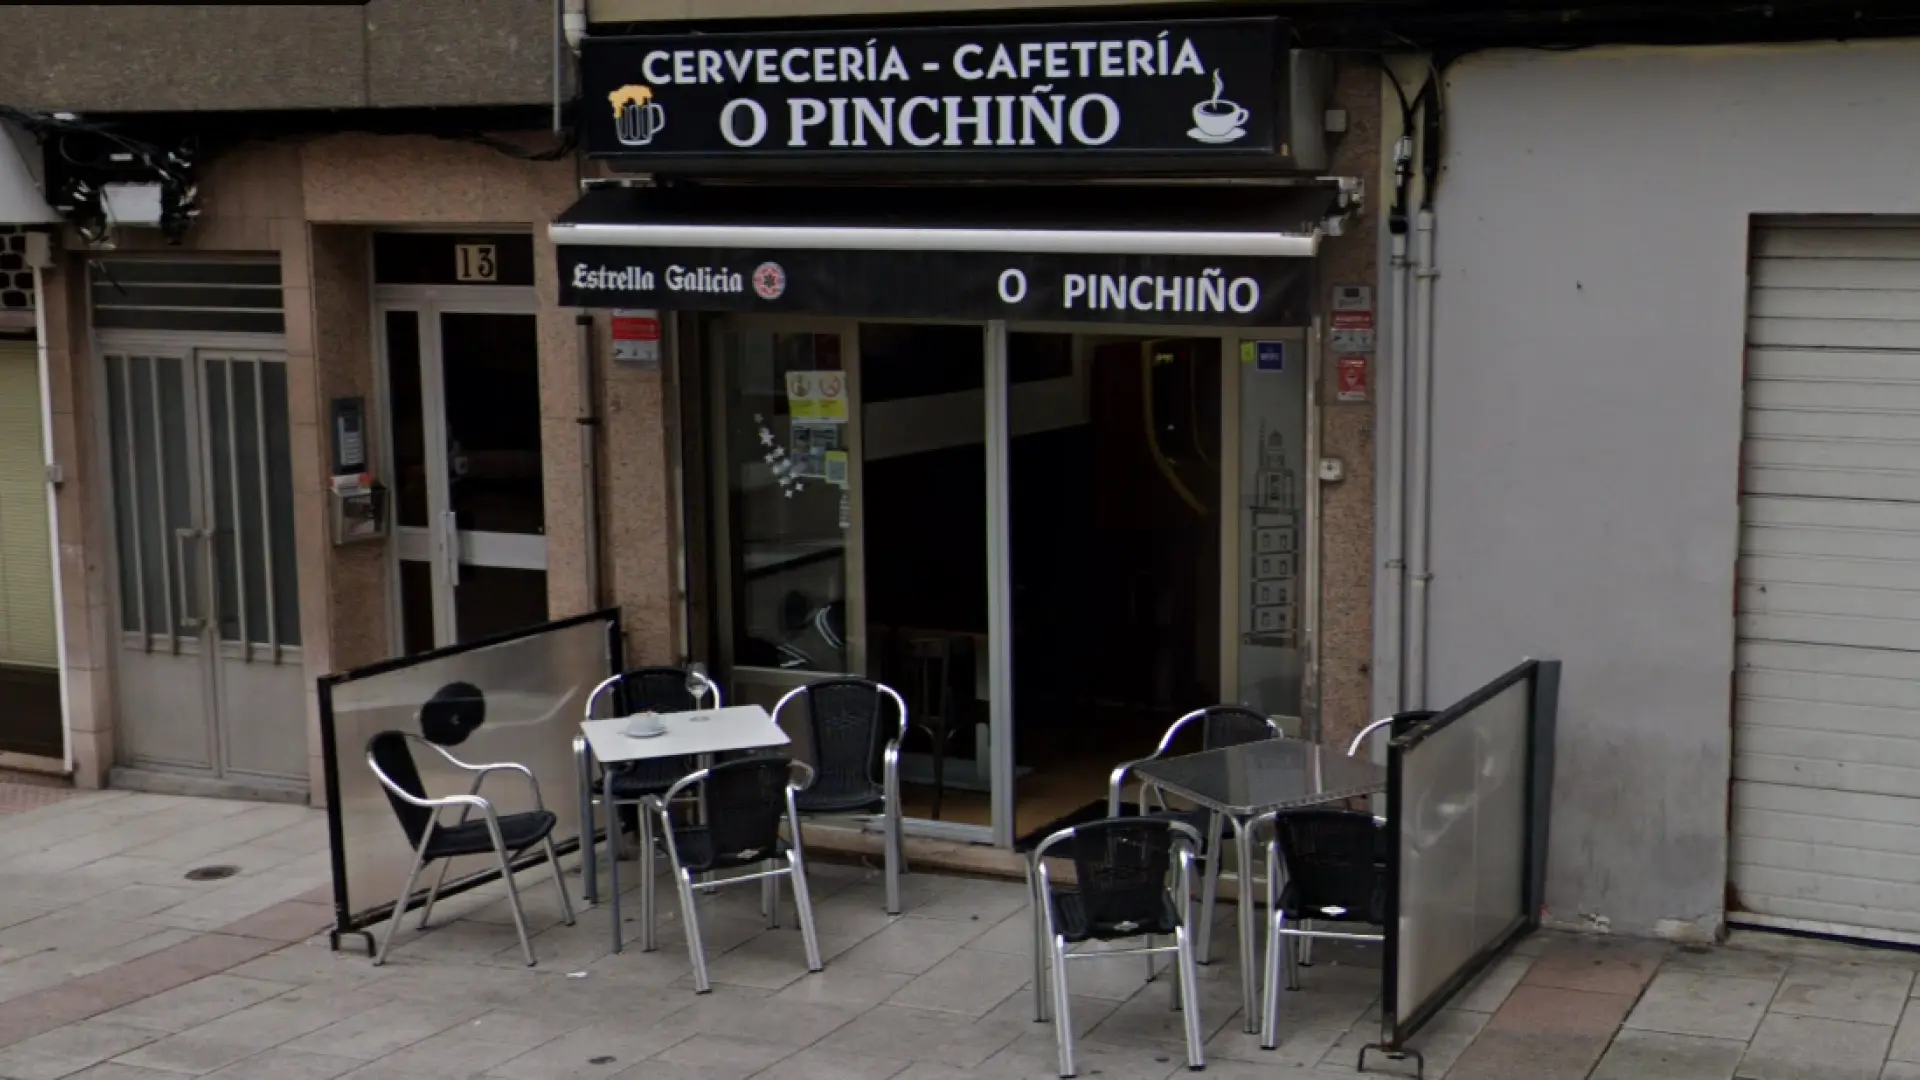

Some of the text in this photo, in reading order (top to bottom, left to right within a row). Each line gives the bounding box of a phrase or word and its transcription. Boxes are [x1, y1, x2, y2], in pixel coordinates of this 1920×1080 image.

[641, 39, 909, 85] CERVECERÍA
[952, 31, 1206, 80] CAFETERÍA
[720, 83, 1120, 147] O PINCHIÑO
[460, 247, 494, 278] 13
[572, 263, 743, 293] Estrella Galicia
[998, 268, 1260, 314] O PINCHIÑO
